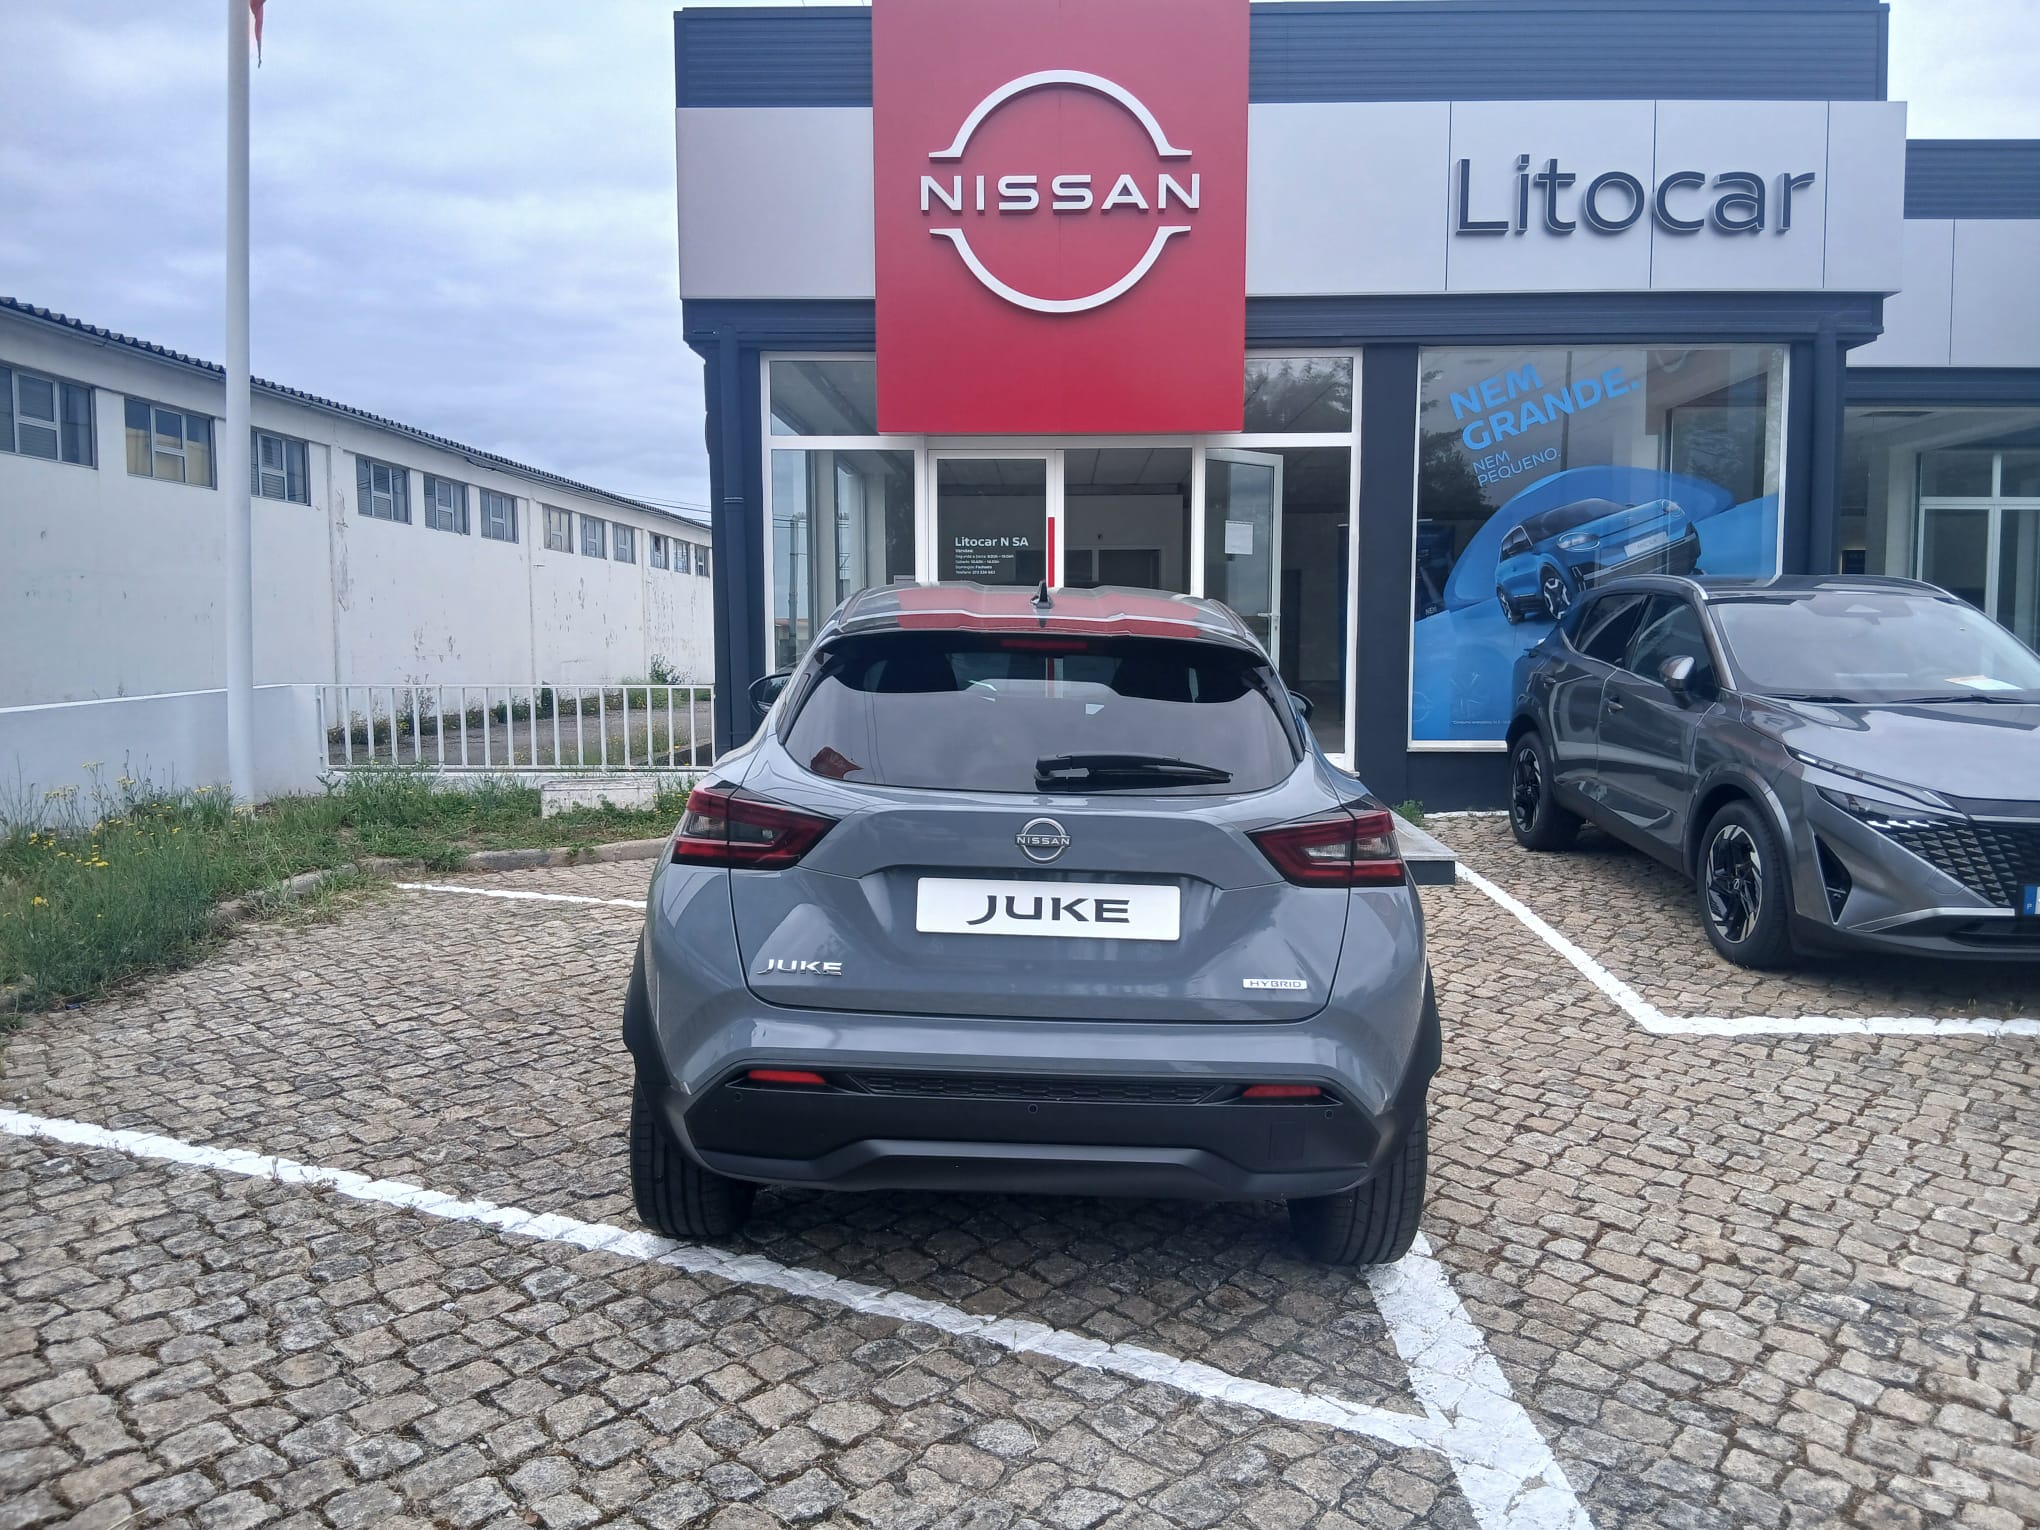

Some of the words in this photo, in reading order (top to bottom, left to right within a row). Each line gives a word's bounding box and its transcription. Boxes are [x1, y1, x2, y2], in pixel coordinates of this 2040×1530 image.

[919, 173, 1200, 212] NISSAN
[1455, 153, 1816, 234] Litocar
[1450, 363, 1543, 420] NEM
[1462, 367, 1641, 451] GRANDE.
[1472, 449, 1511, 474] NEM
[1477, 447, 1561, 488] PEQUENO.
[955, 536, 998, 547] Litocar
[1000, 537, 1009, 547] N
[1012, 537, 1029, 547] SA
[1016, 836, 1070, 845] NISSAN
[966, 894, 1131, 926] JUKE
[757, 957, 842, 977] JUKE
[1249, 980, 1302, 988] HYBRID
